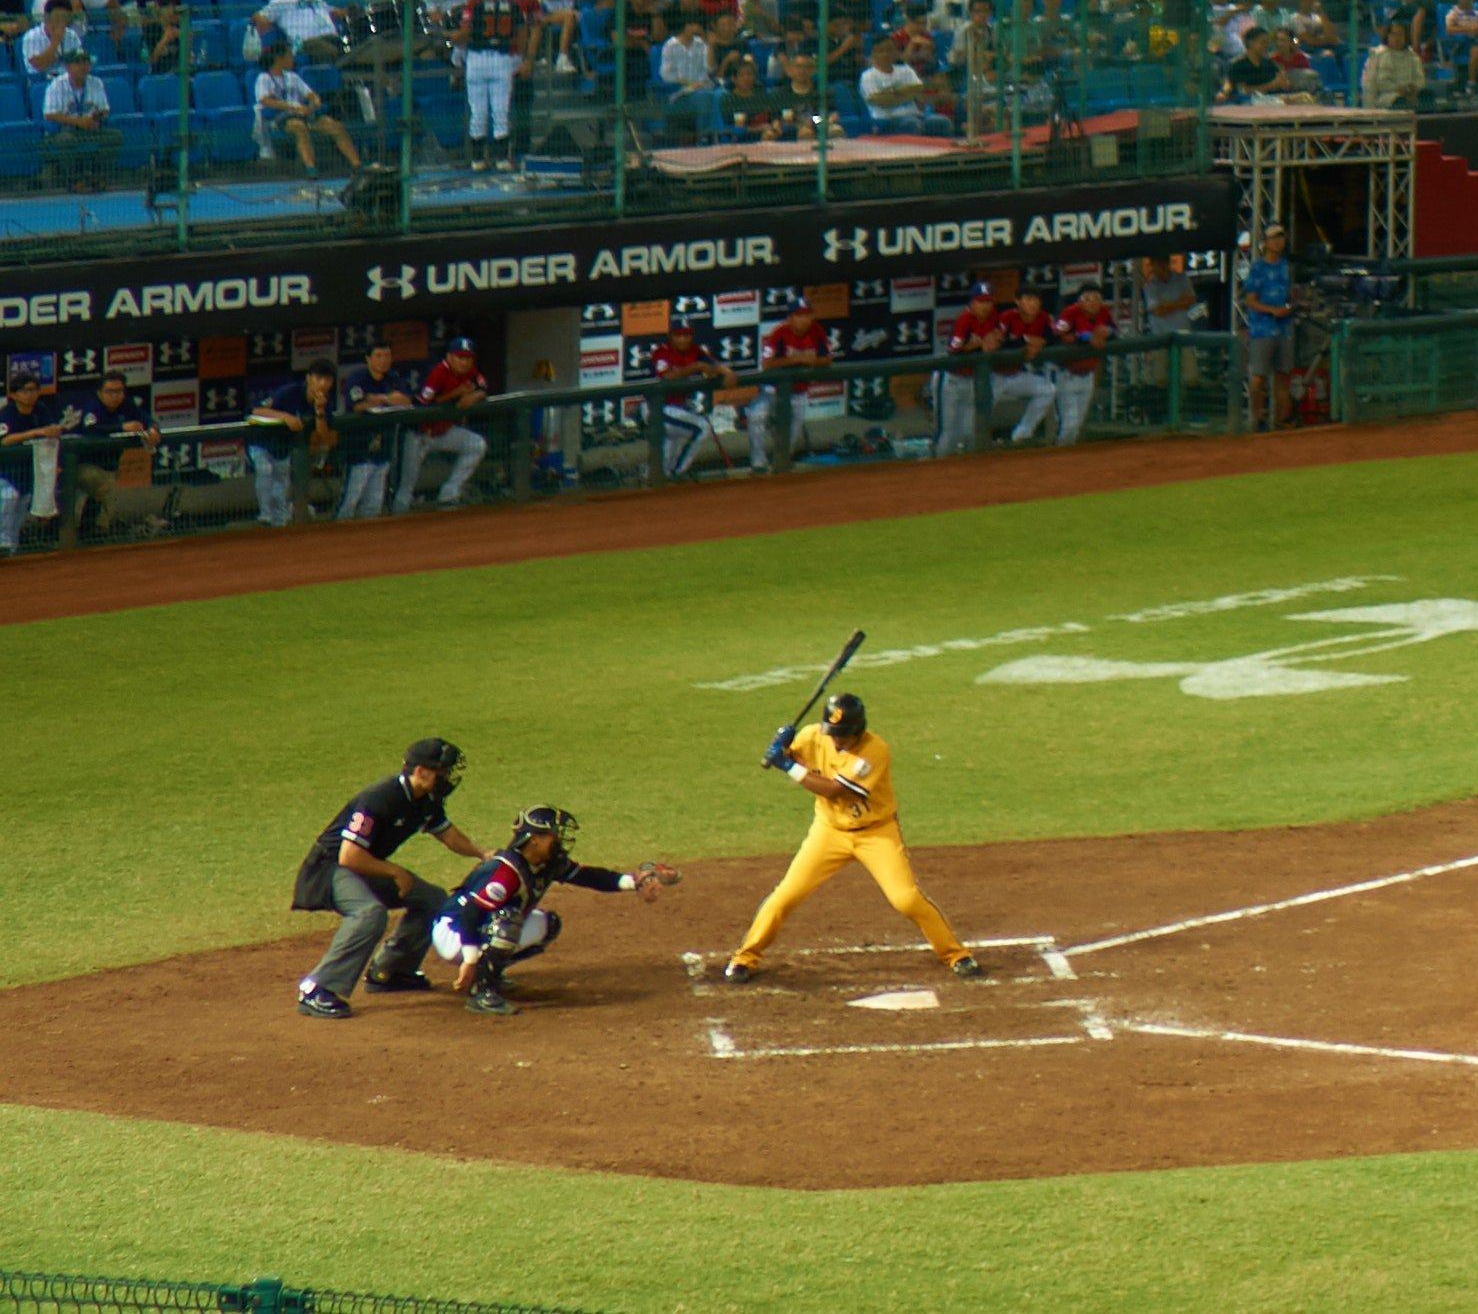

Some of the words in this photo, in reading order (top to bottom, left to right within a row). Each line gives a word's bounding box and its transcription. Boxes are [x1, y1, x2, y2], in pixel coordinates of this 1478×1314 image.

[876, 218, 1014, 257] UNDER
[1024, 202, 1195, 244] ARMOUR
[426, 252, 576, 295] UNDER
[588, 236, 777, 281] ARMOUR
[105, 274, 315, 320] ARMOUR
